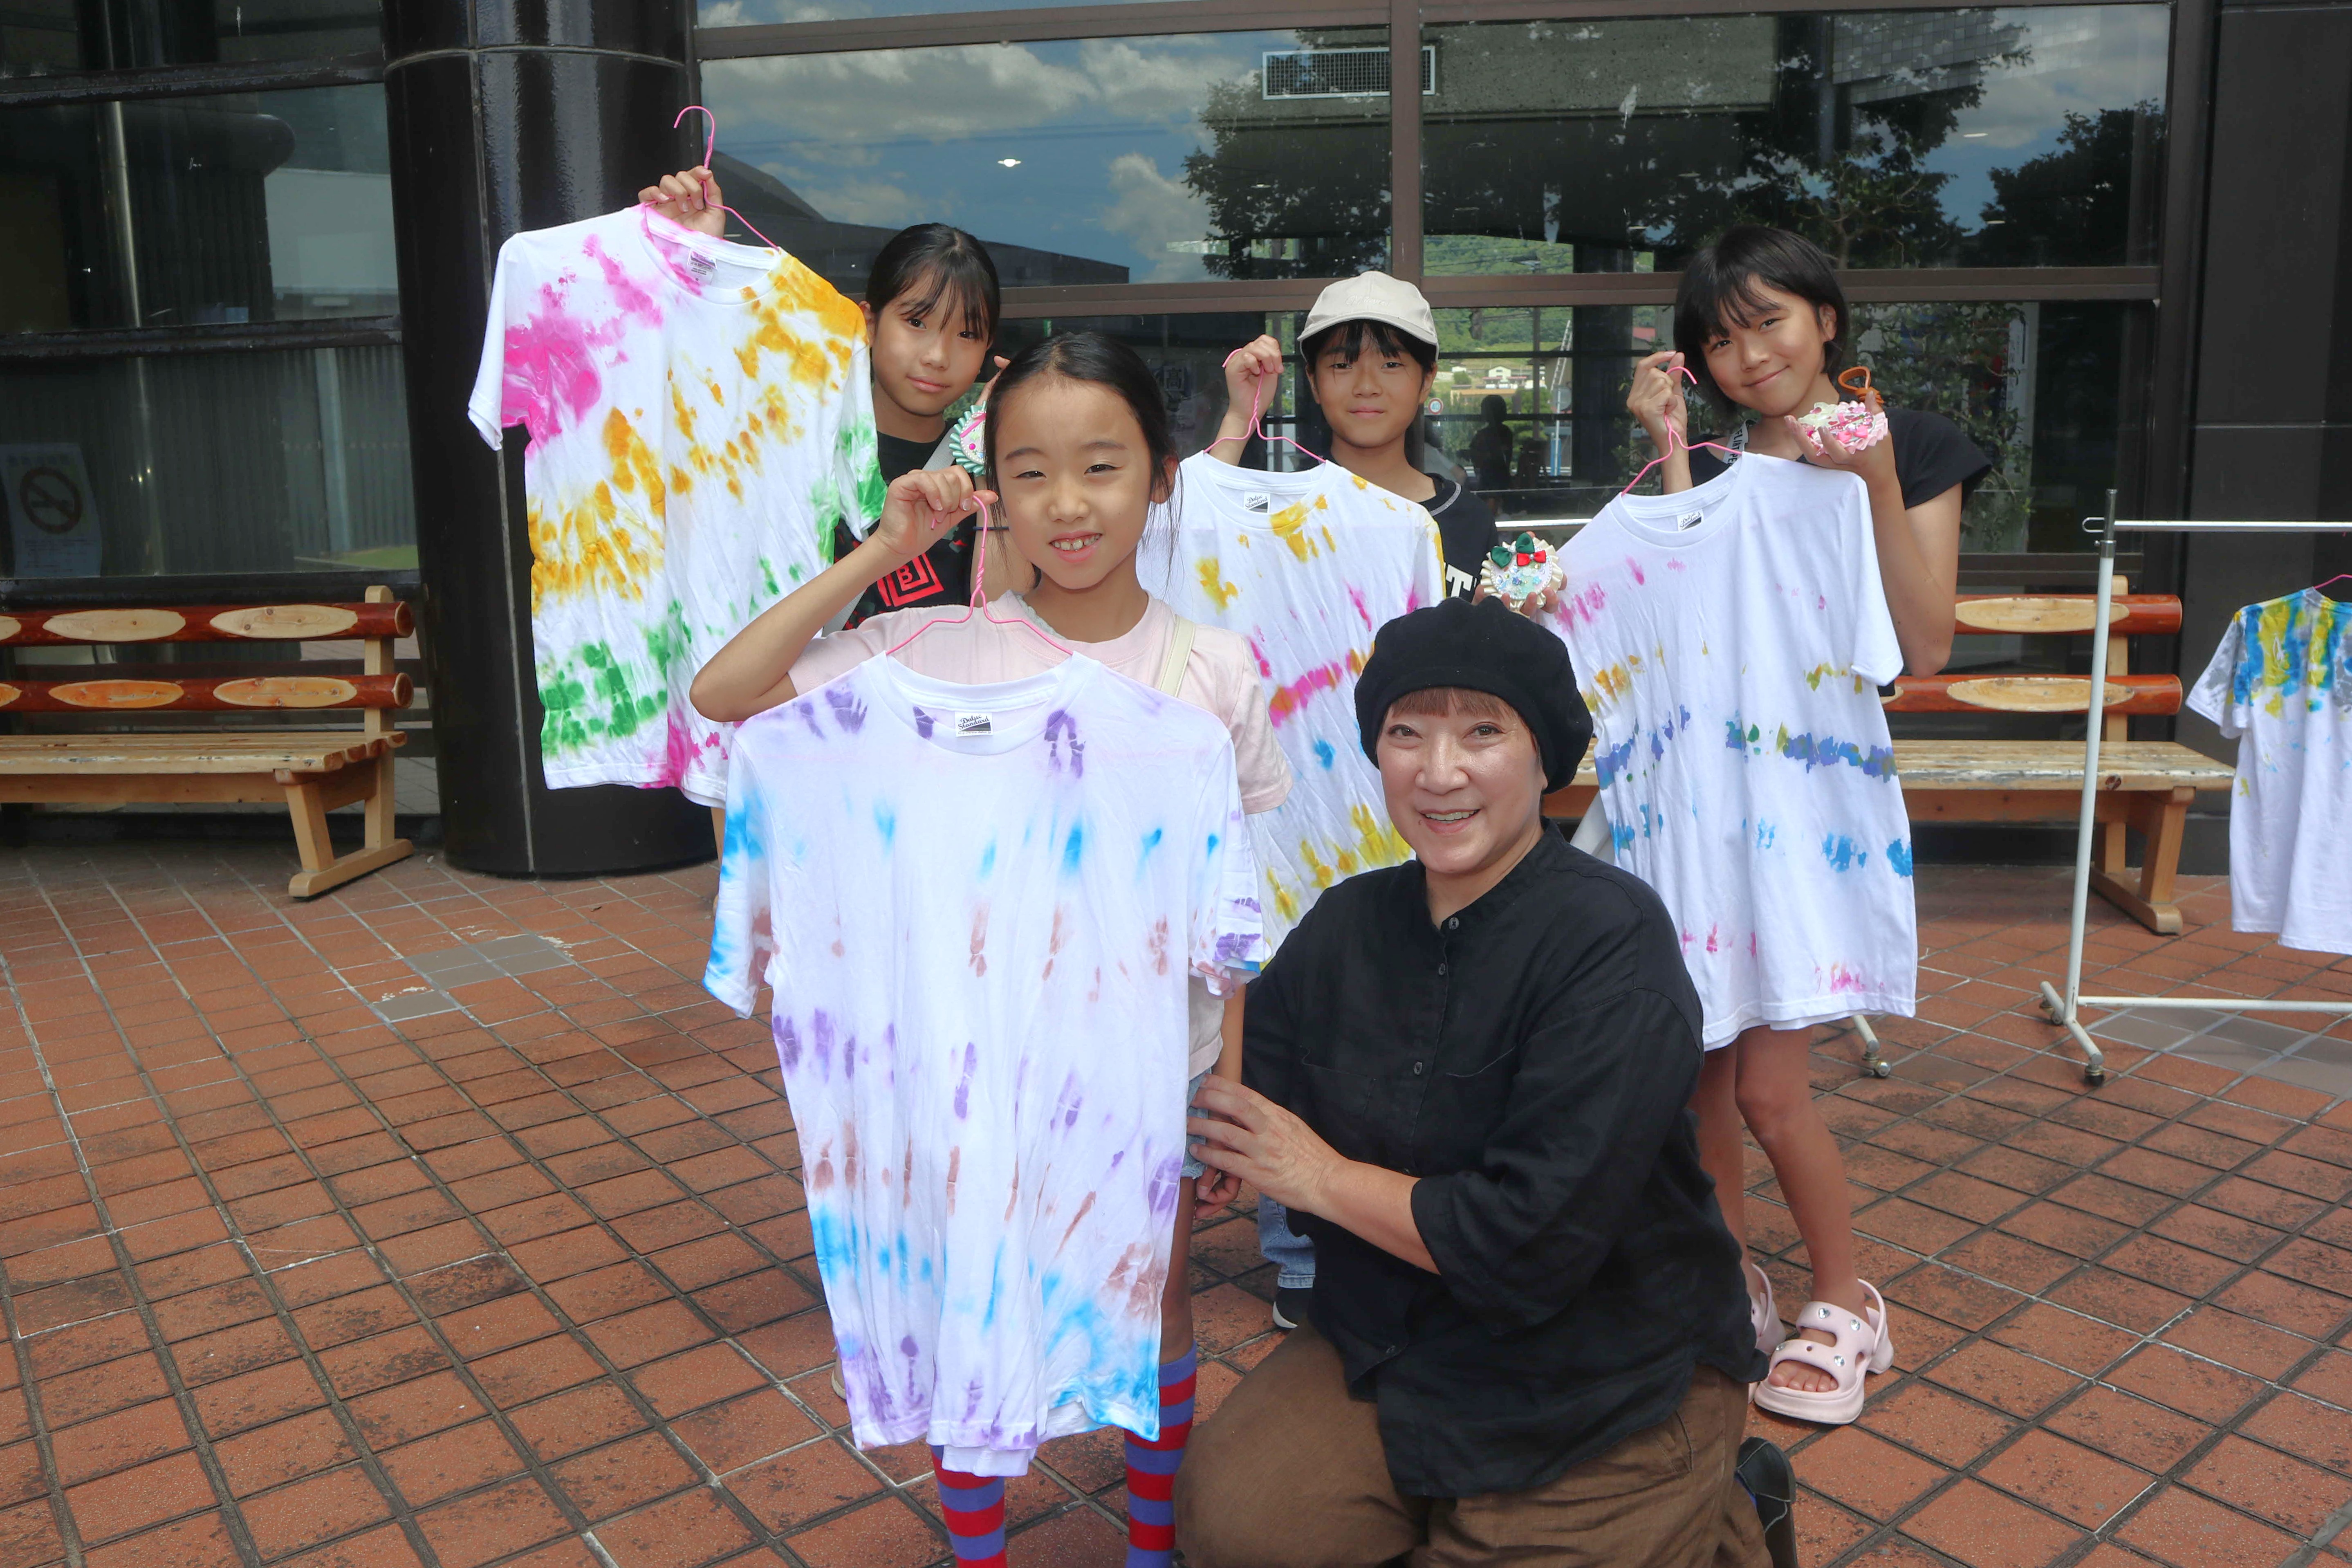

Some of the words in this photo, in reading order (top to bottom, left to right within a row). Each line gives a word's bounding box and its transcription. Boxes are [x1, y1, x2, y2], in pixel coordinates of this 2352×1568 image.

[1245, 496, 1268, 510] Standard
[1247, 495, 1263, 504] Daluc
[958, 715, 989, 730] Standard
[960, 714, 982, 724] Daluc
